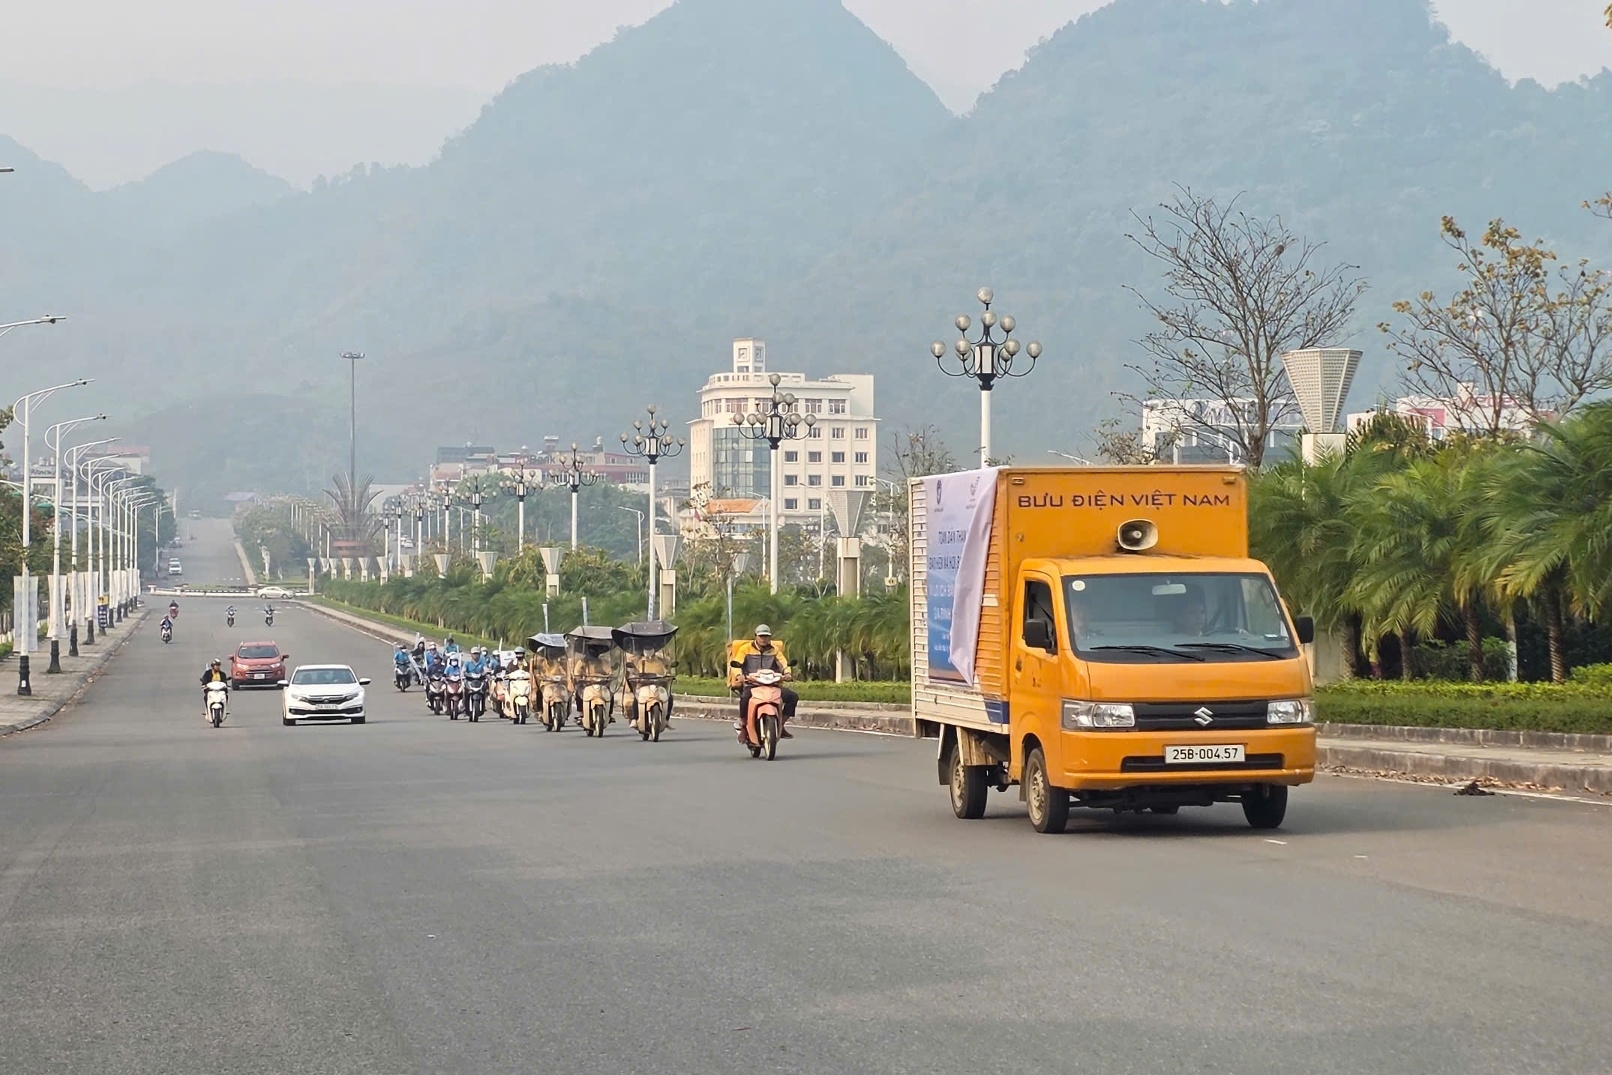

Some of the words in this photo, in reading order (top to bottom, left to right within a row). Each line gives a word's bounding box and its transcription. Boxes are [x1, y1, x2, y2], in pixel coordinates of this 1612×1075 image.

[1018, 492, 1063, 508] BƯU
[1072, 489, 1125, 511] ĐIỆN
[1130, 489, 1176, 510] VIỆT
[1183, 494, 1230, 507] NAM
[1172, 747, 1239, 760] 25B-004.57
